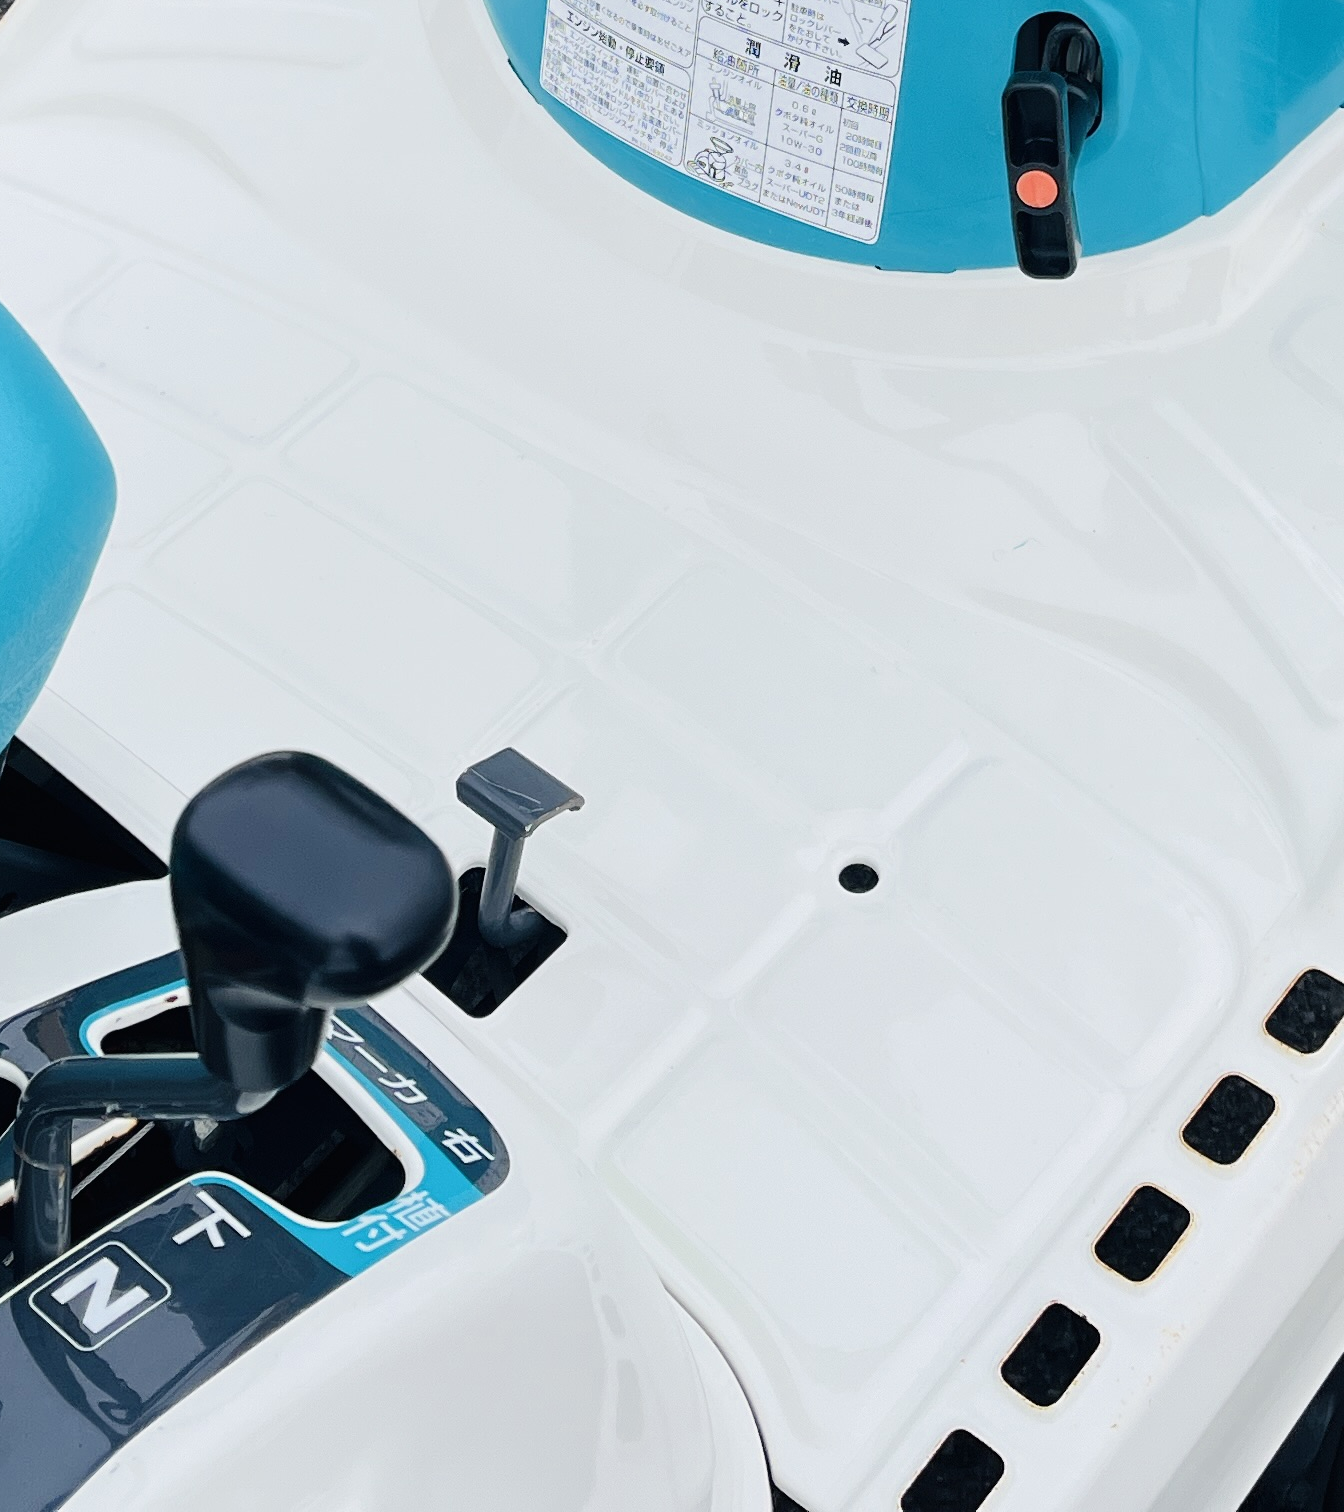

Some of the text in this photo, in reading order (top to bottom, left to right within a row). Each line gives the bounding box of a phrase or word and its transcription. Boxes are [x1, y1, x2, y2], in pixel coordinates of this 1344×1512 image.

[704, 0, 752, 29] すること。
[790, 13, 842, 35] ロックレバー
[708, 62, 763, 91] エンジンオイル
[745, 37, 842, 87] 潤滑油
[774, 107, 835, 134] クボタ純オイル
[847, 94, 891, 121] 交換時期
[780, 135, 823, 157] 10W-30
[782, 123, 824, 144] スーパーG
[766, 177, 826, 206] スーパーUDT2
[767, 165, 827, 193] クボタ純オイル
[442, 1128, 495, 1164] 右
[171, 1190, 252, 1248] 下
[340, 1190, 452, 1253] 植付
[51, 1257, 150, 1334] N
